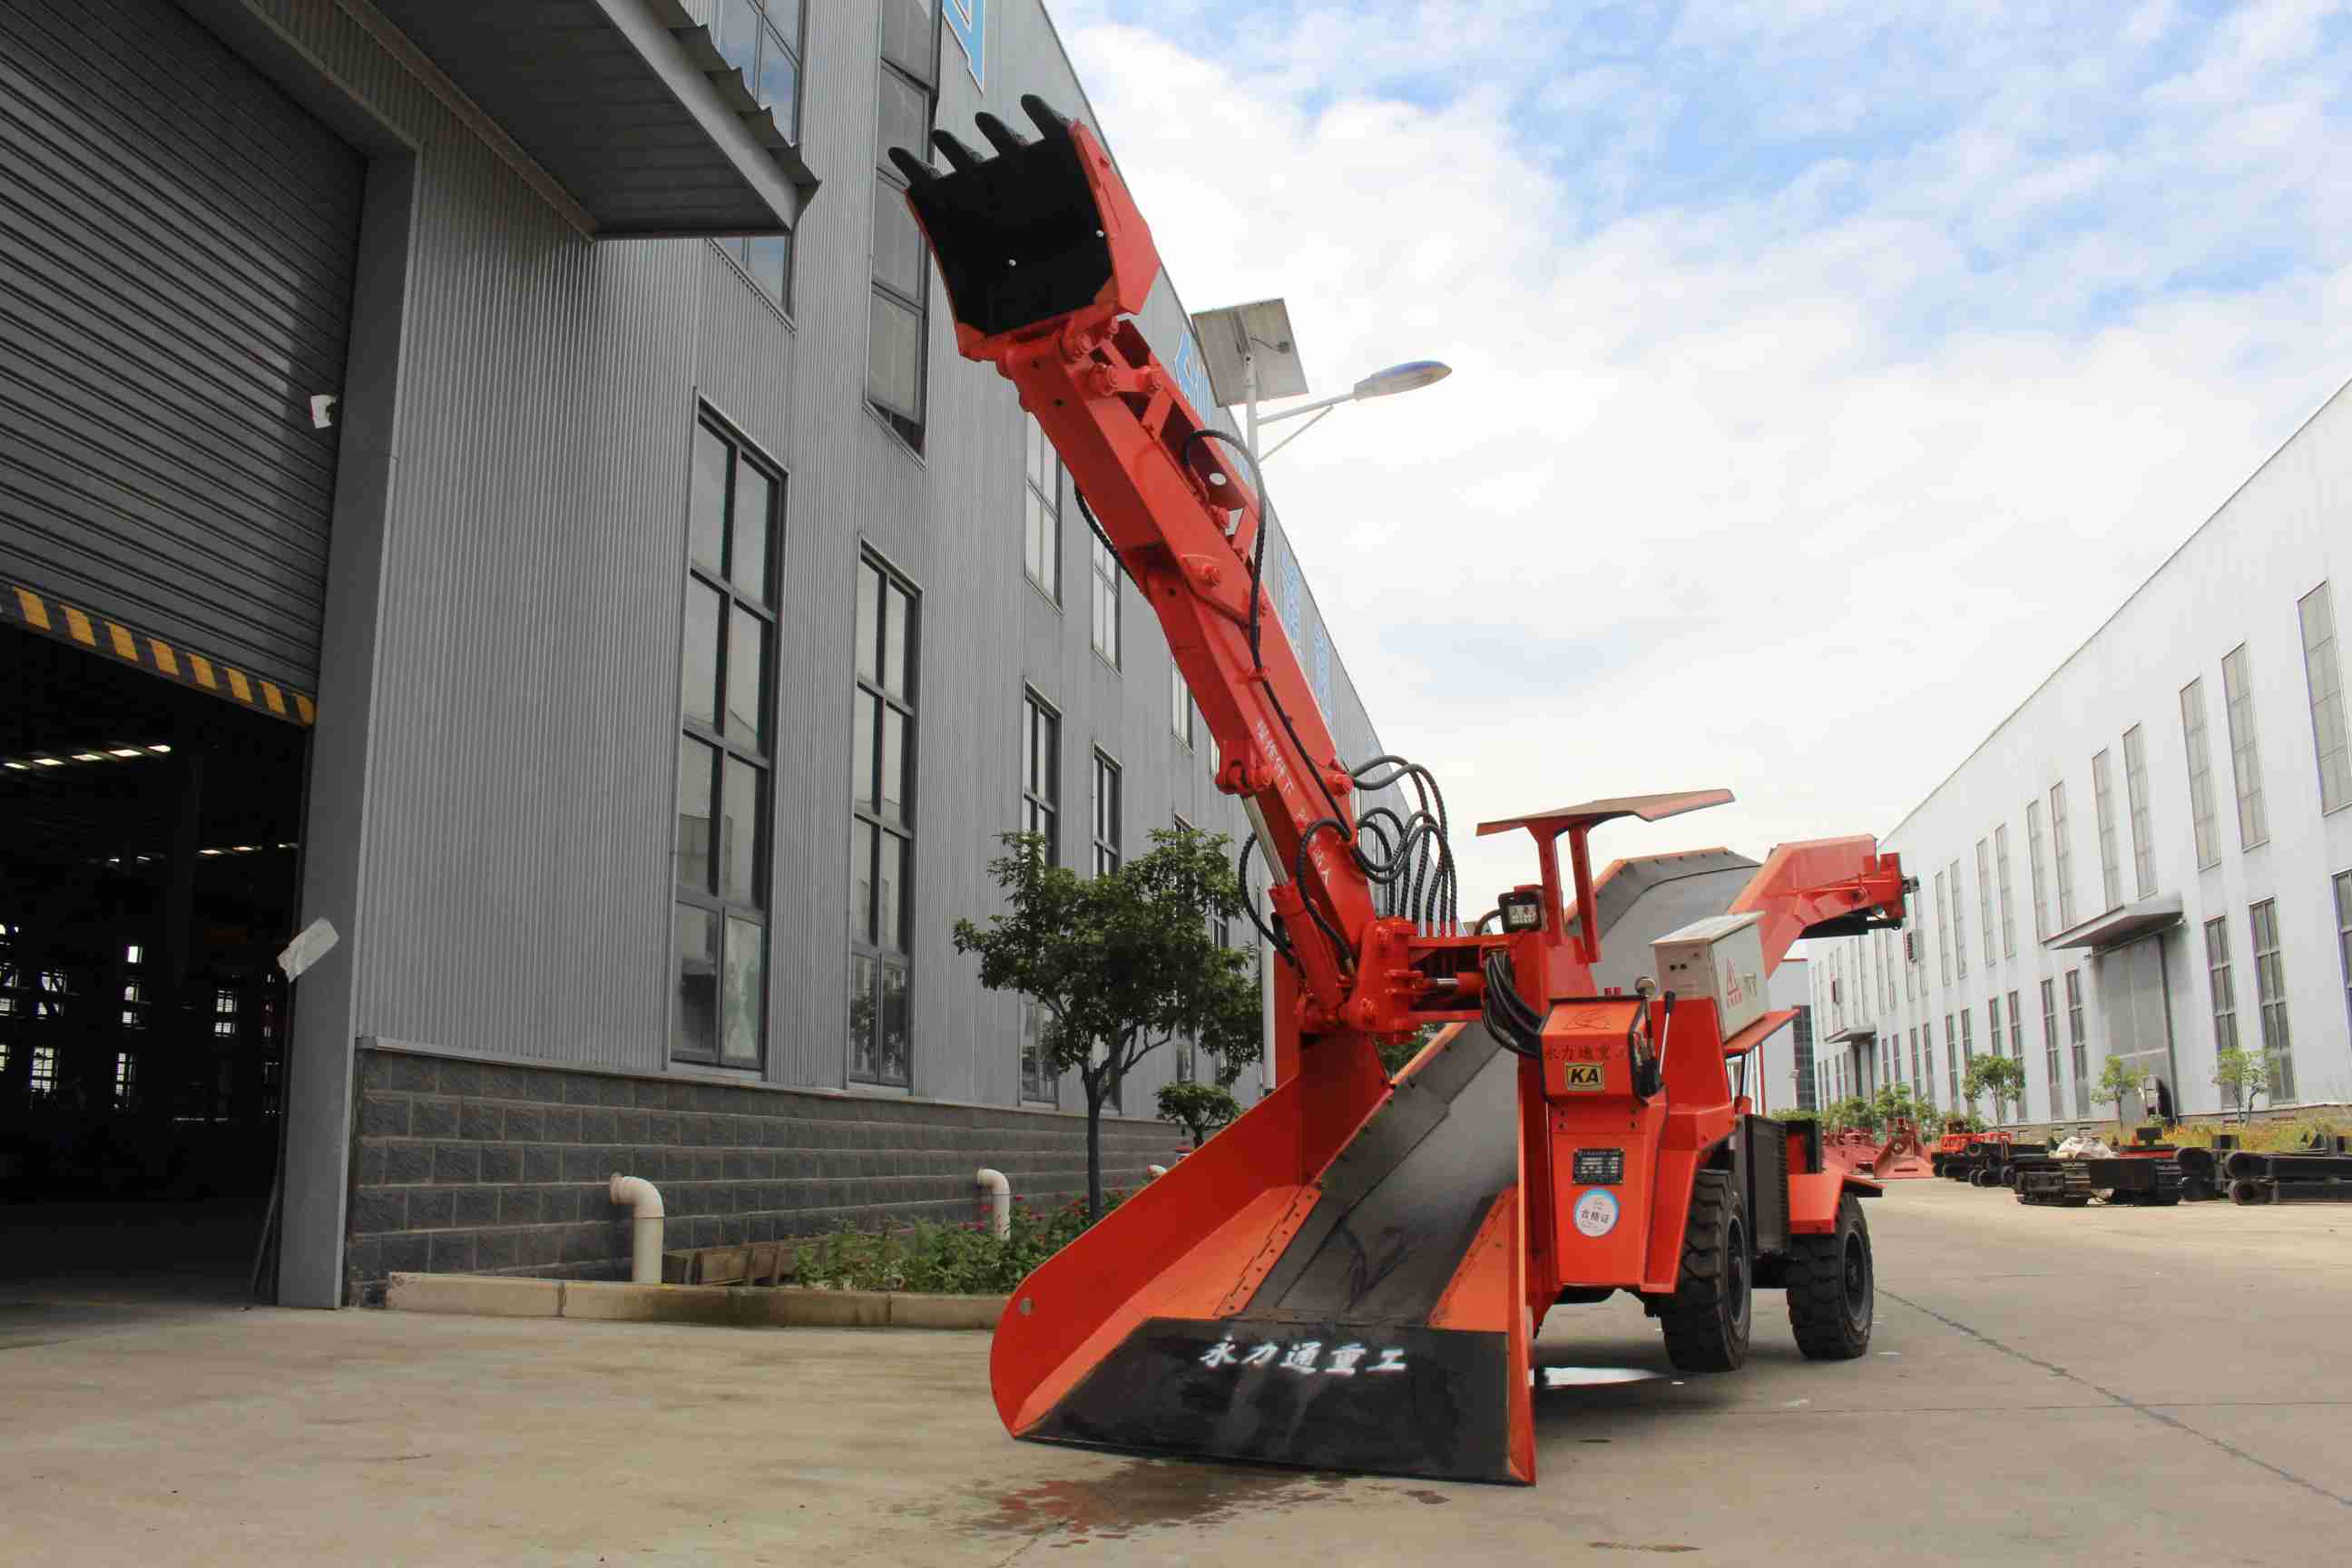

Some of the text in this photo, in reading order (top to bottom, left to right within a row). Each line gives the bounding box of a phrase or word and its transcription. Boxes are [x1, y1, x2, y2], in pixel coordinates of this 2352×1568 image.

[1571, 1068, 1599, 1083] KA
[1581, 1210, 1611, 1224] 合格证
[1199, 1334, 1407, 1376] 永力通重工
